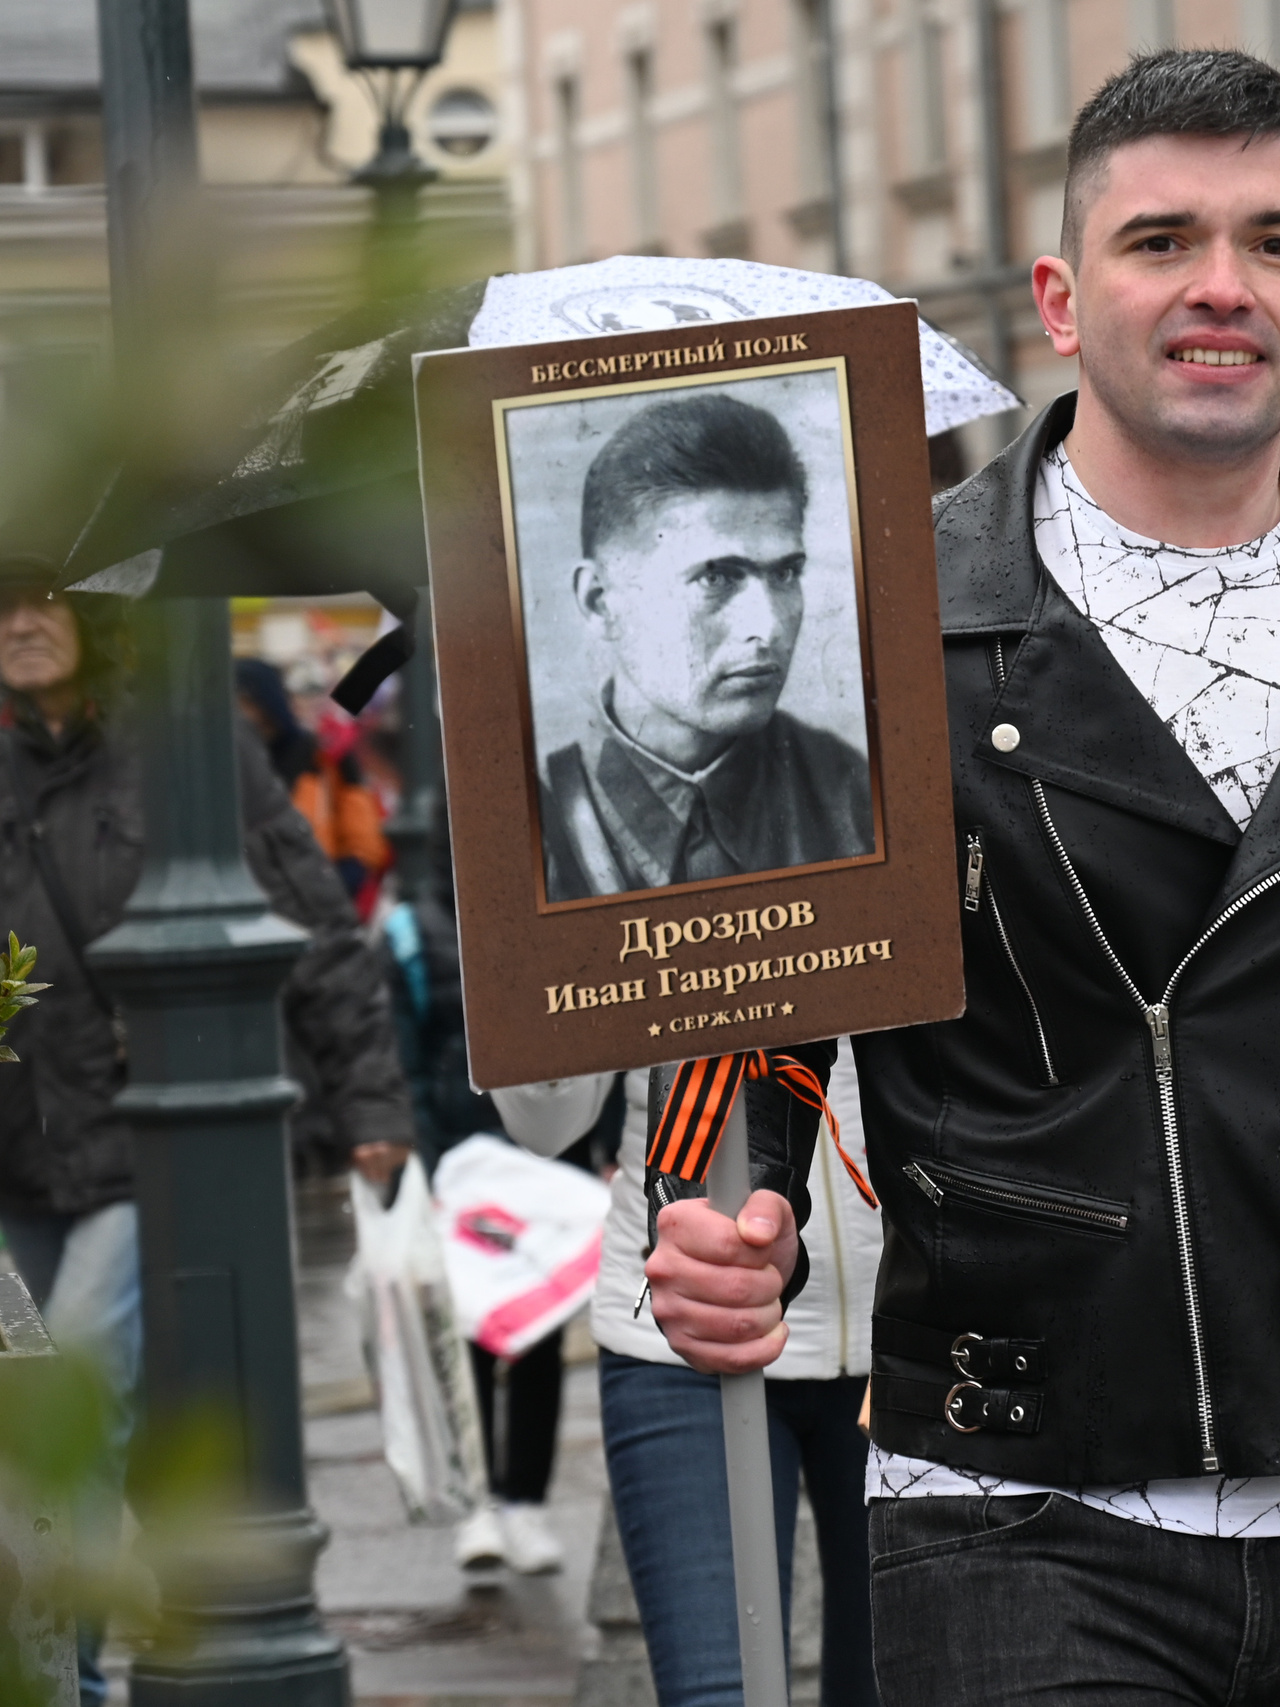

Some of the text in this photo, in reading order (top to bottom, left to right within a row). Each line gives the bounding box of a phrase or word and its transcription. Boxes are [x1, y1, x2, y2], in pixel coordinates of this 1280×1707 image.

[531, 332, 810, 383] БЕССМЕРТНЫЙ ПОЛК
[619, 900, 815, 963] Дроздов
[544, 939, 894, 1015] Иван Гаврилович
[669, 1003, 777, 1033] СЕРЖАНТ
